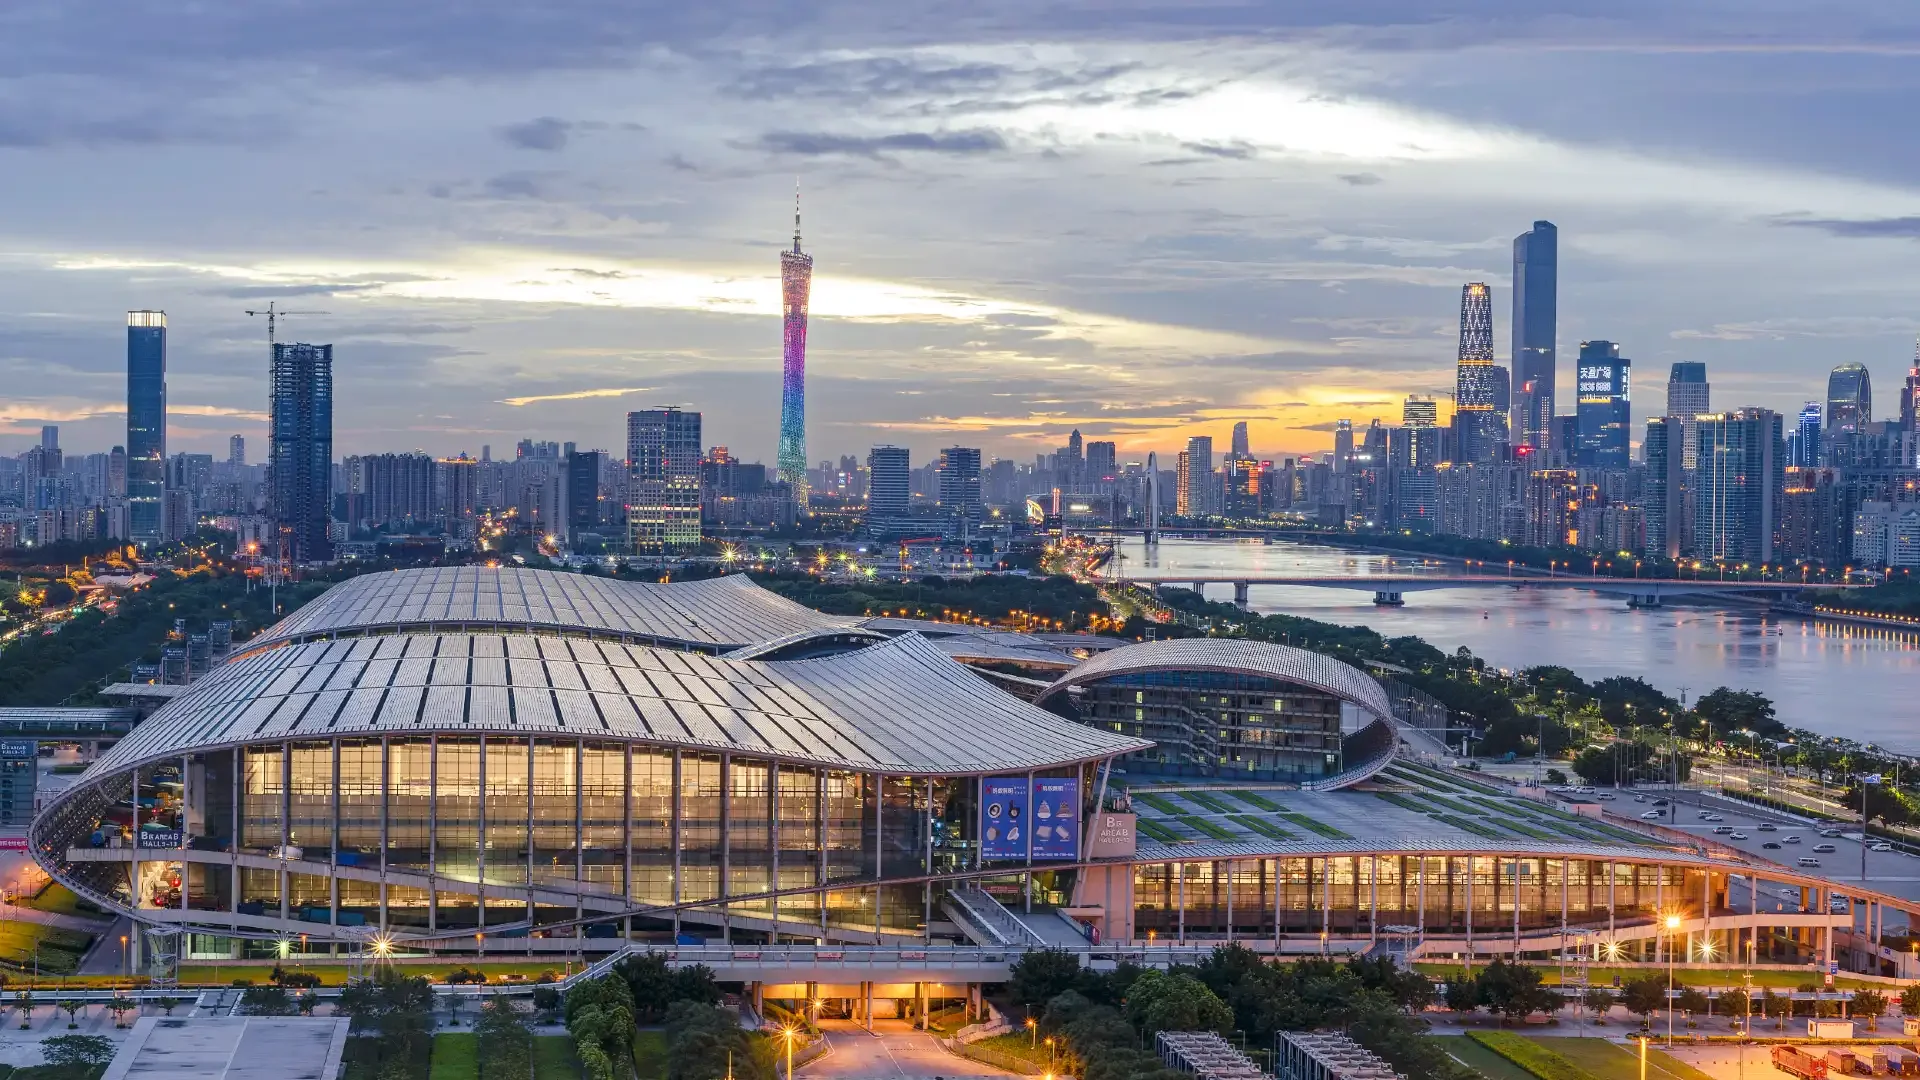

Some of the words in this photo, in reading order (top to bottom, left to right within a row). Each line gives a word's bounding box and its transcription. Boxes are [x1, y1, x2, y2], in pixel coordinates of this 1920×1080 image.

[1580, 366, 1611, 379] 天盈广场
[1100, 829, 1121, 837] AREA
[1122, 828, 1128, 837] B
